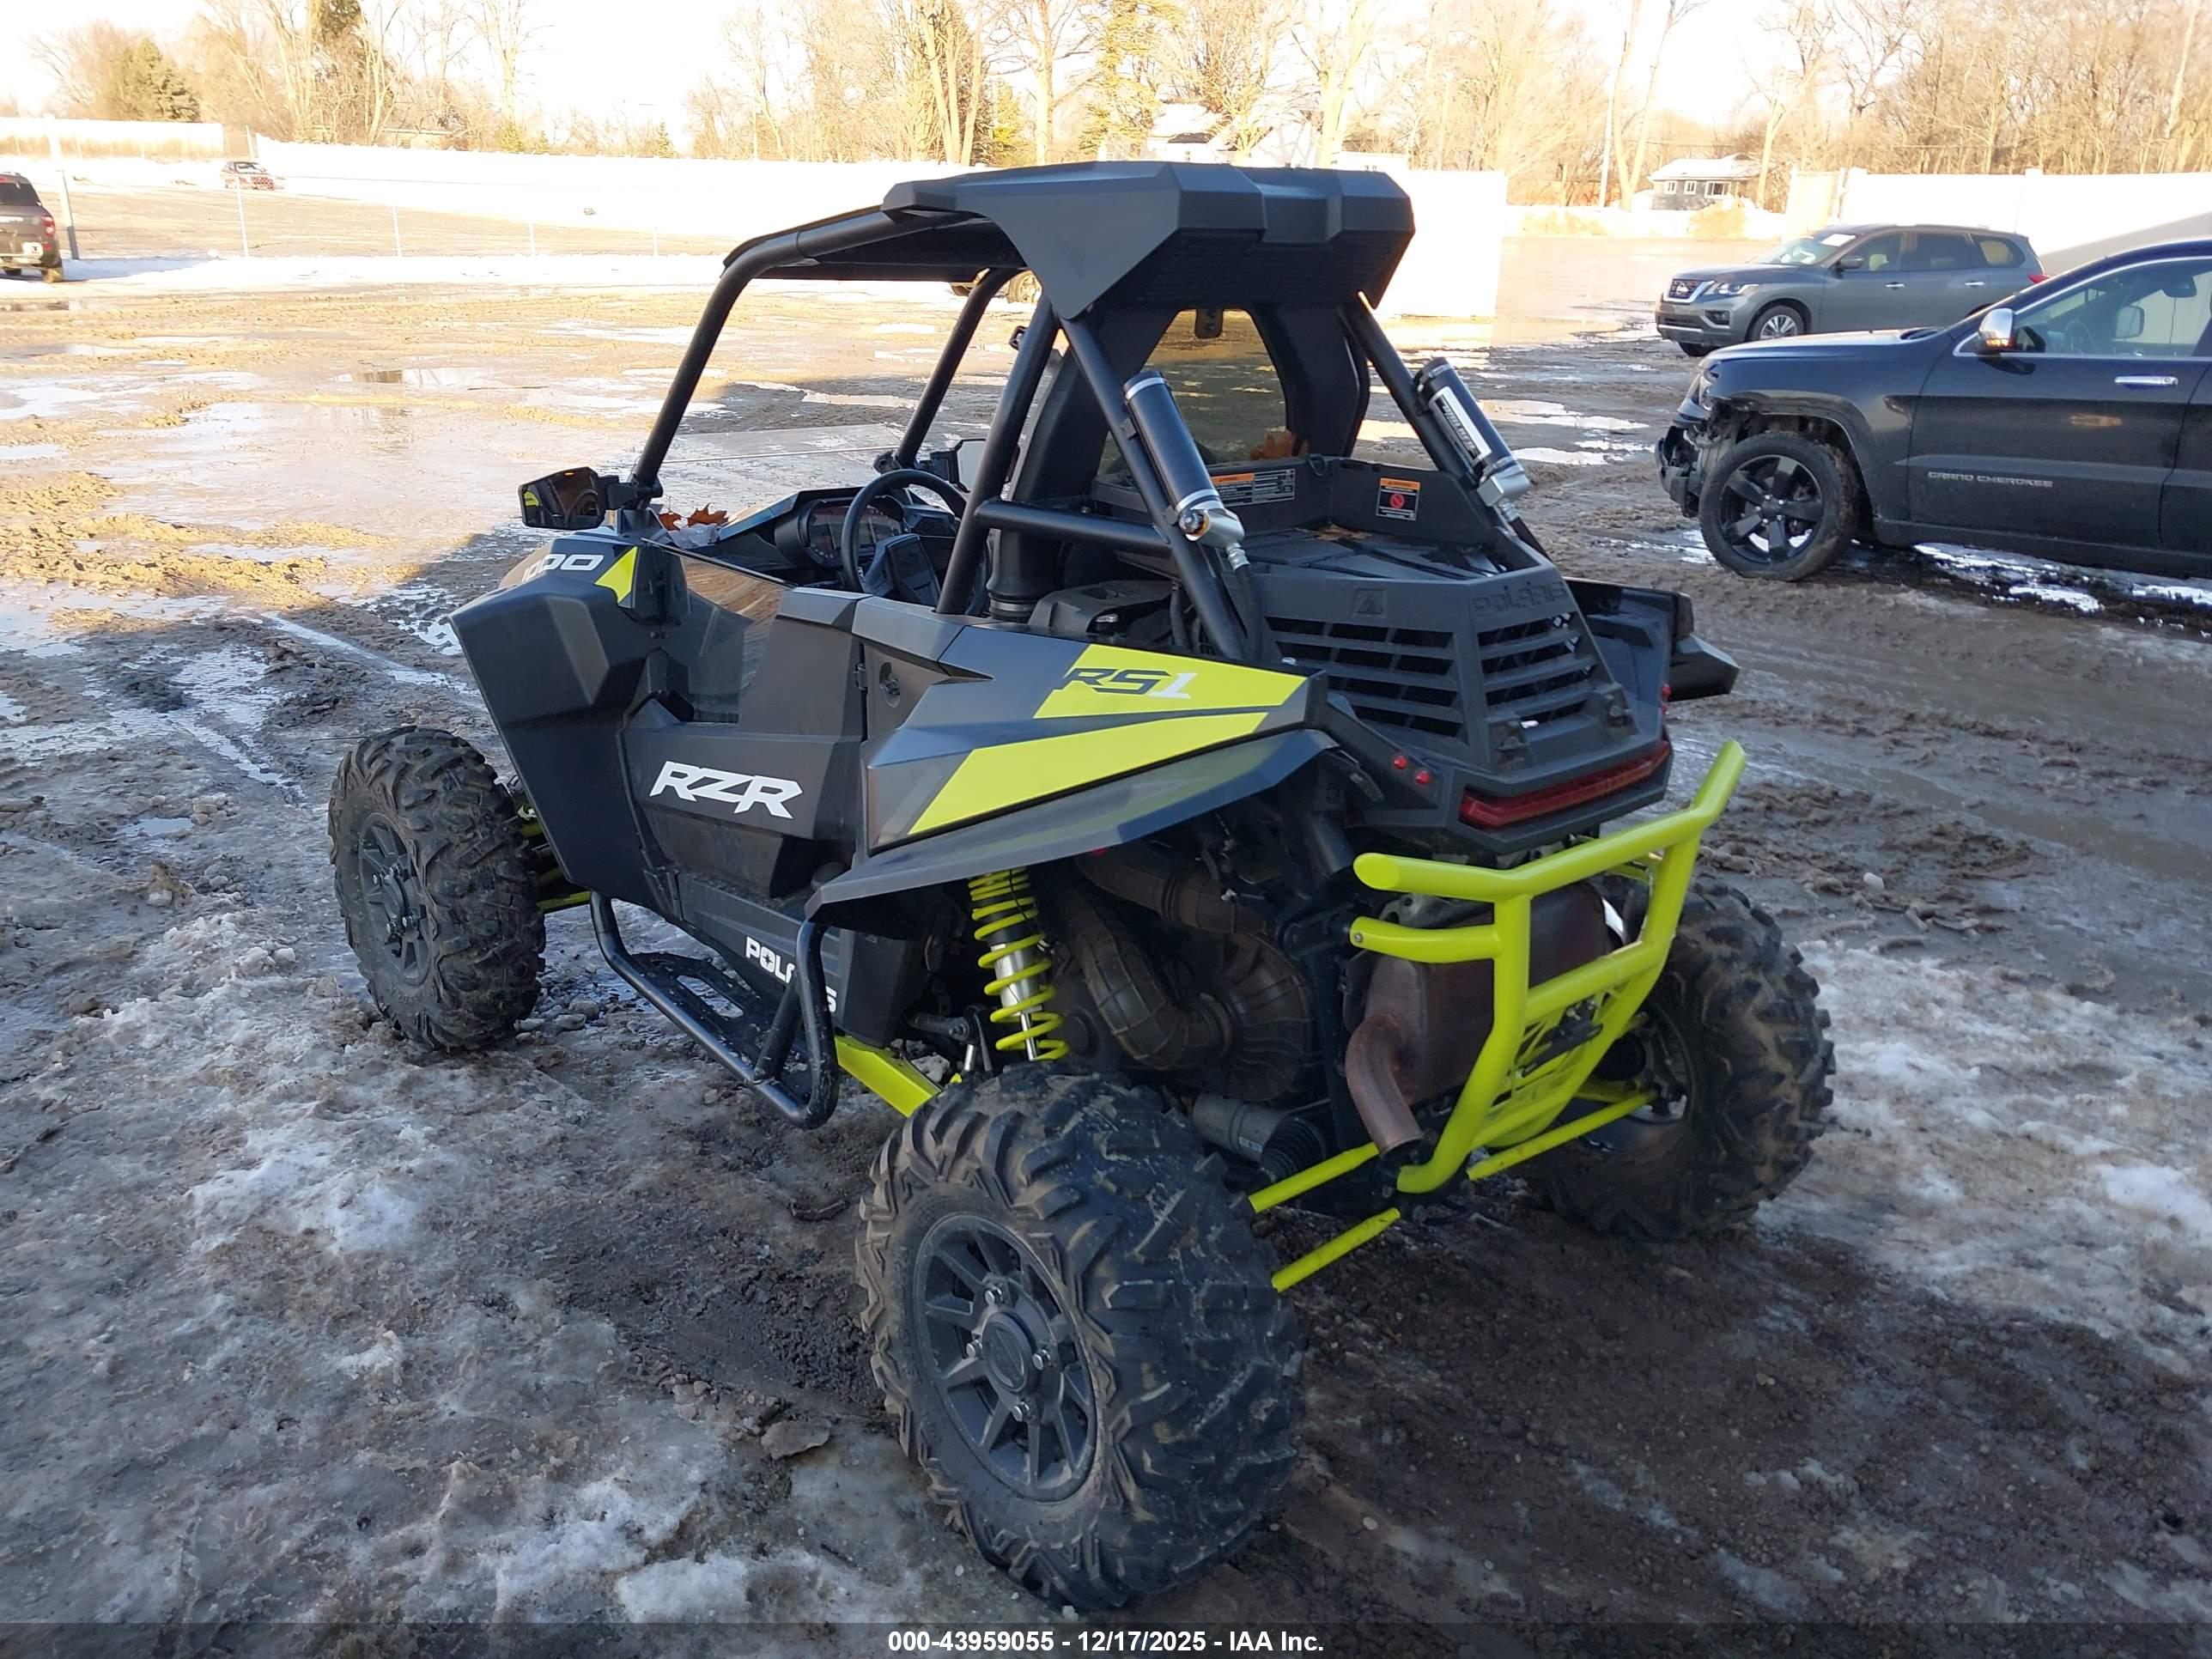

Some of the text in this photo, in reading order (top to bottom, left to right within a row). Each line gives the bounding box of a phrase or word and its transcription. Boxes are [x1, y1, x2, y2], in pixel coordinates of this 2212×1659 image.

[1928, 471, 2053, 488] GRAND CHEROKEE
[1060, 668, 1197, 699] RS1
[649, 761, 803, 819] RZR
[745, 936, 837, 1013] POLS
